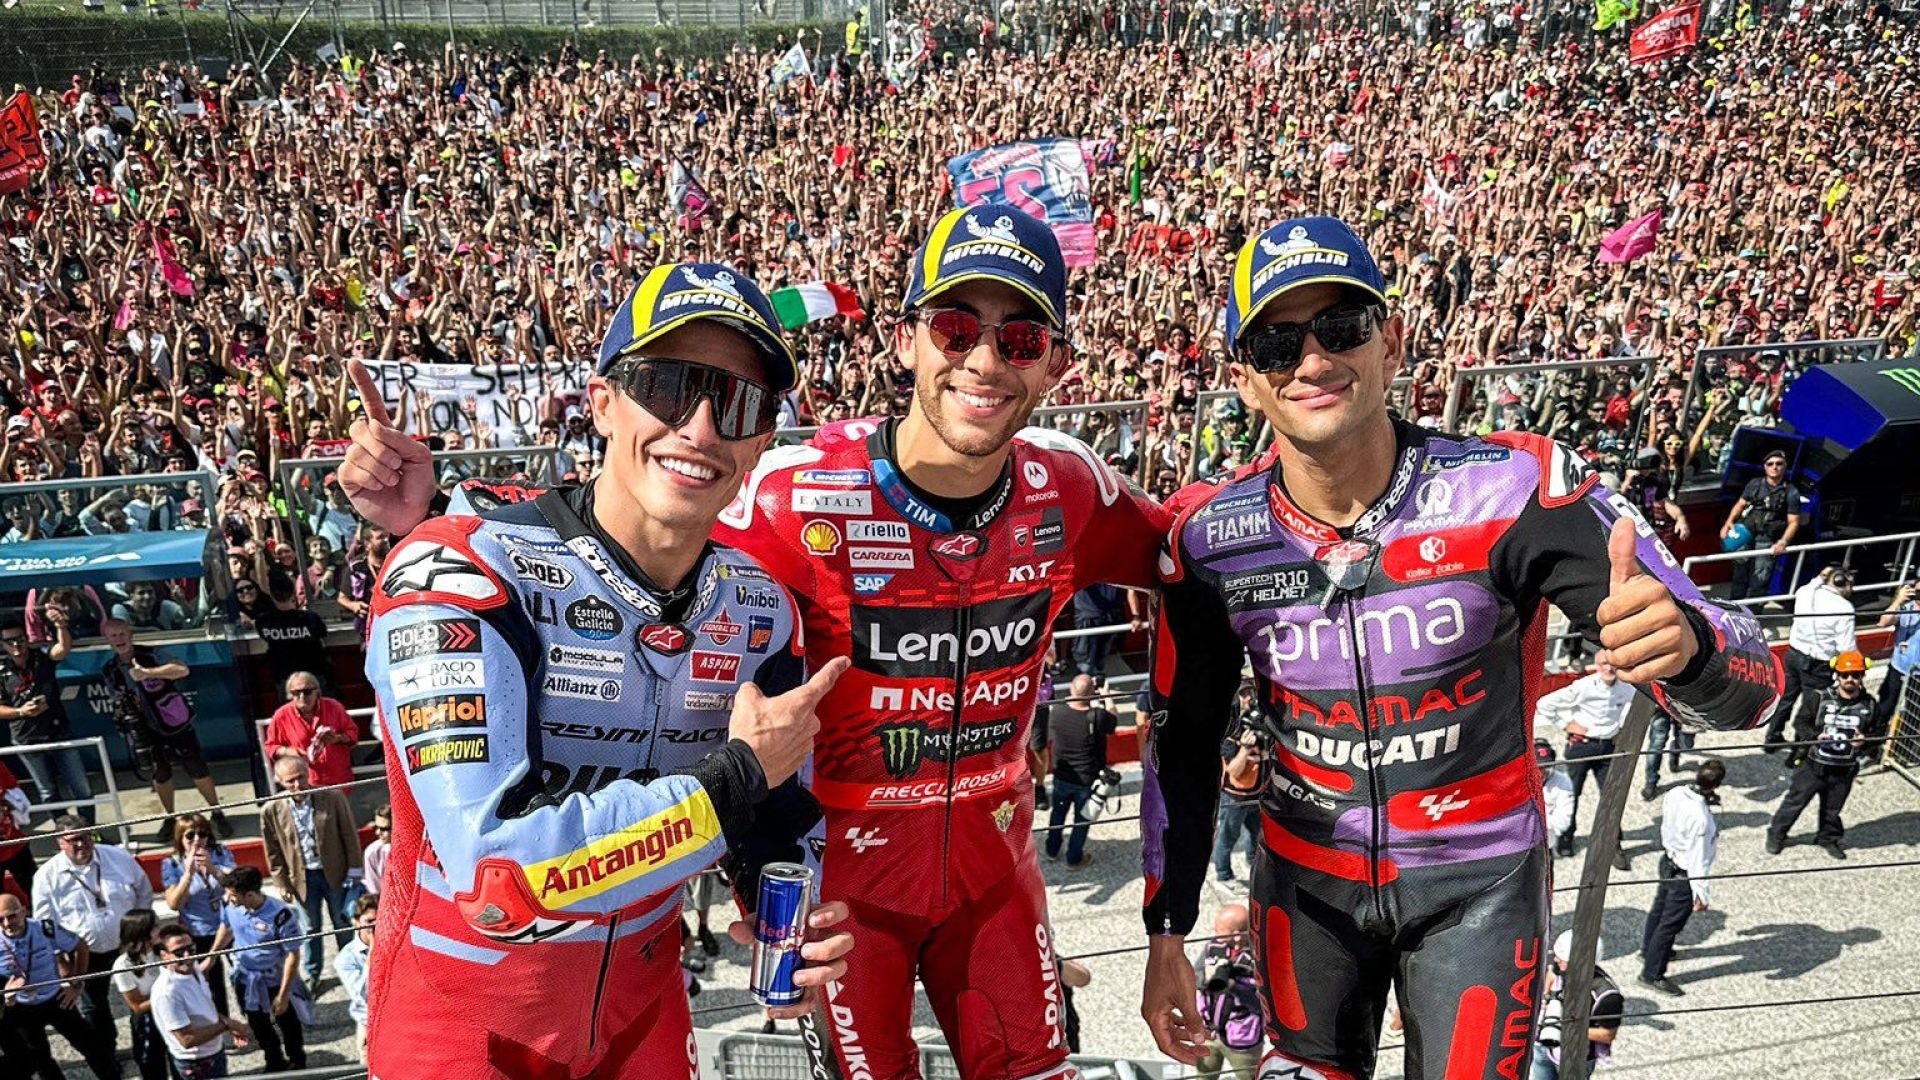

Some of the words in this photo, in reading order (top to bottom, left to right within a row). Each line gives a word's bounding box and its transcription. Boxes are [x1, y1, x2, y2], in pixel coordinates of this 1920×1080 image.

[943, 243, 1044, 274] MICHELIN
[1252, 252, 1349, 294] MICHELIN
[815, 473, 864, 482] MICHELIN
[800, 496, 866, 508] EATALY
[975, 477, 1012, 528] Lenovo
[1025, 490, 1059, 504] motorola
[903, 498, 937, 528] TIM
[864, 523, 906, 538] riello
[1034, 524, 1061, 537] Lenovo
[1206, 510, 1271, 544] FIAMM
[851, 551, 911, 561] CARRERA
[1008, 560, 1055, 583] KYT
[1274, 570, 1309, 588] R10
[854, 577, 886, 591] SAP
[1253, 585, 1310, 602] HELMET
[736, 585, 780, 609] Unibat
[574, 606, 614, 620] Estrella
[262, 626, 311, 640] POLIZIA
[575, 617, 613, 630] Galicia
[869, 617, 1036, 662] Lenovo
[1257, 597, 1465, 675] prima
[432, 675, 476, 687] LUNA
[545, 676, 597, 695] Allianz
[400, 696, 484, 732] Kapriol
[940, 739, 1002, 756] EERGY
[1296, 723, 1461, 771] DUCATI
[541, 816, 693, 899] Antangin
[759, 919, 786, 939] Red
[1035, 923, 1057, 1026] DAIKO
